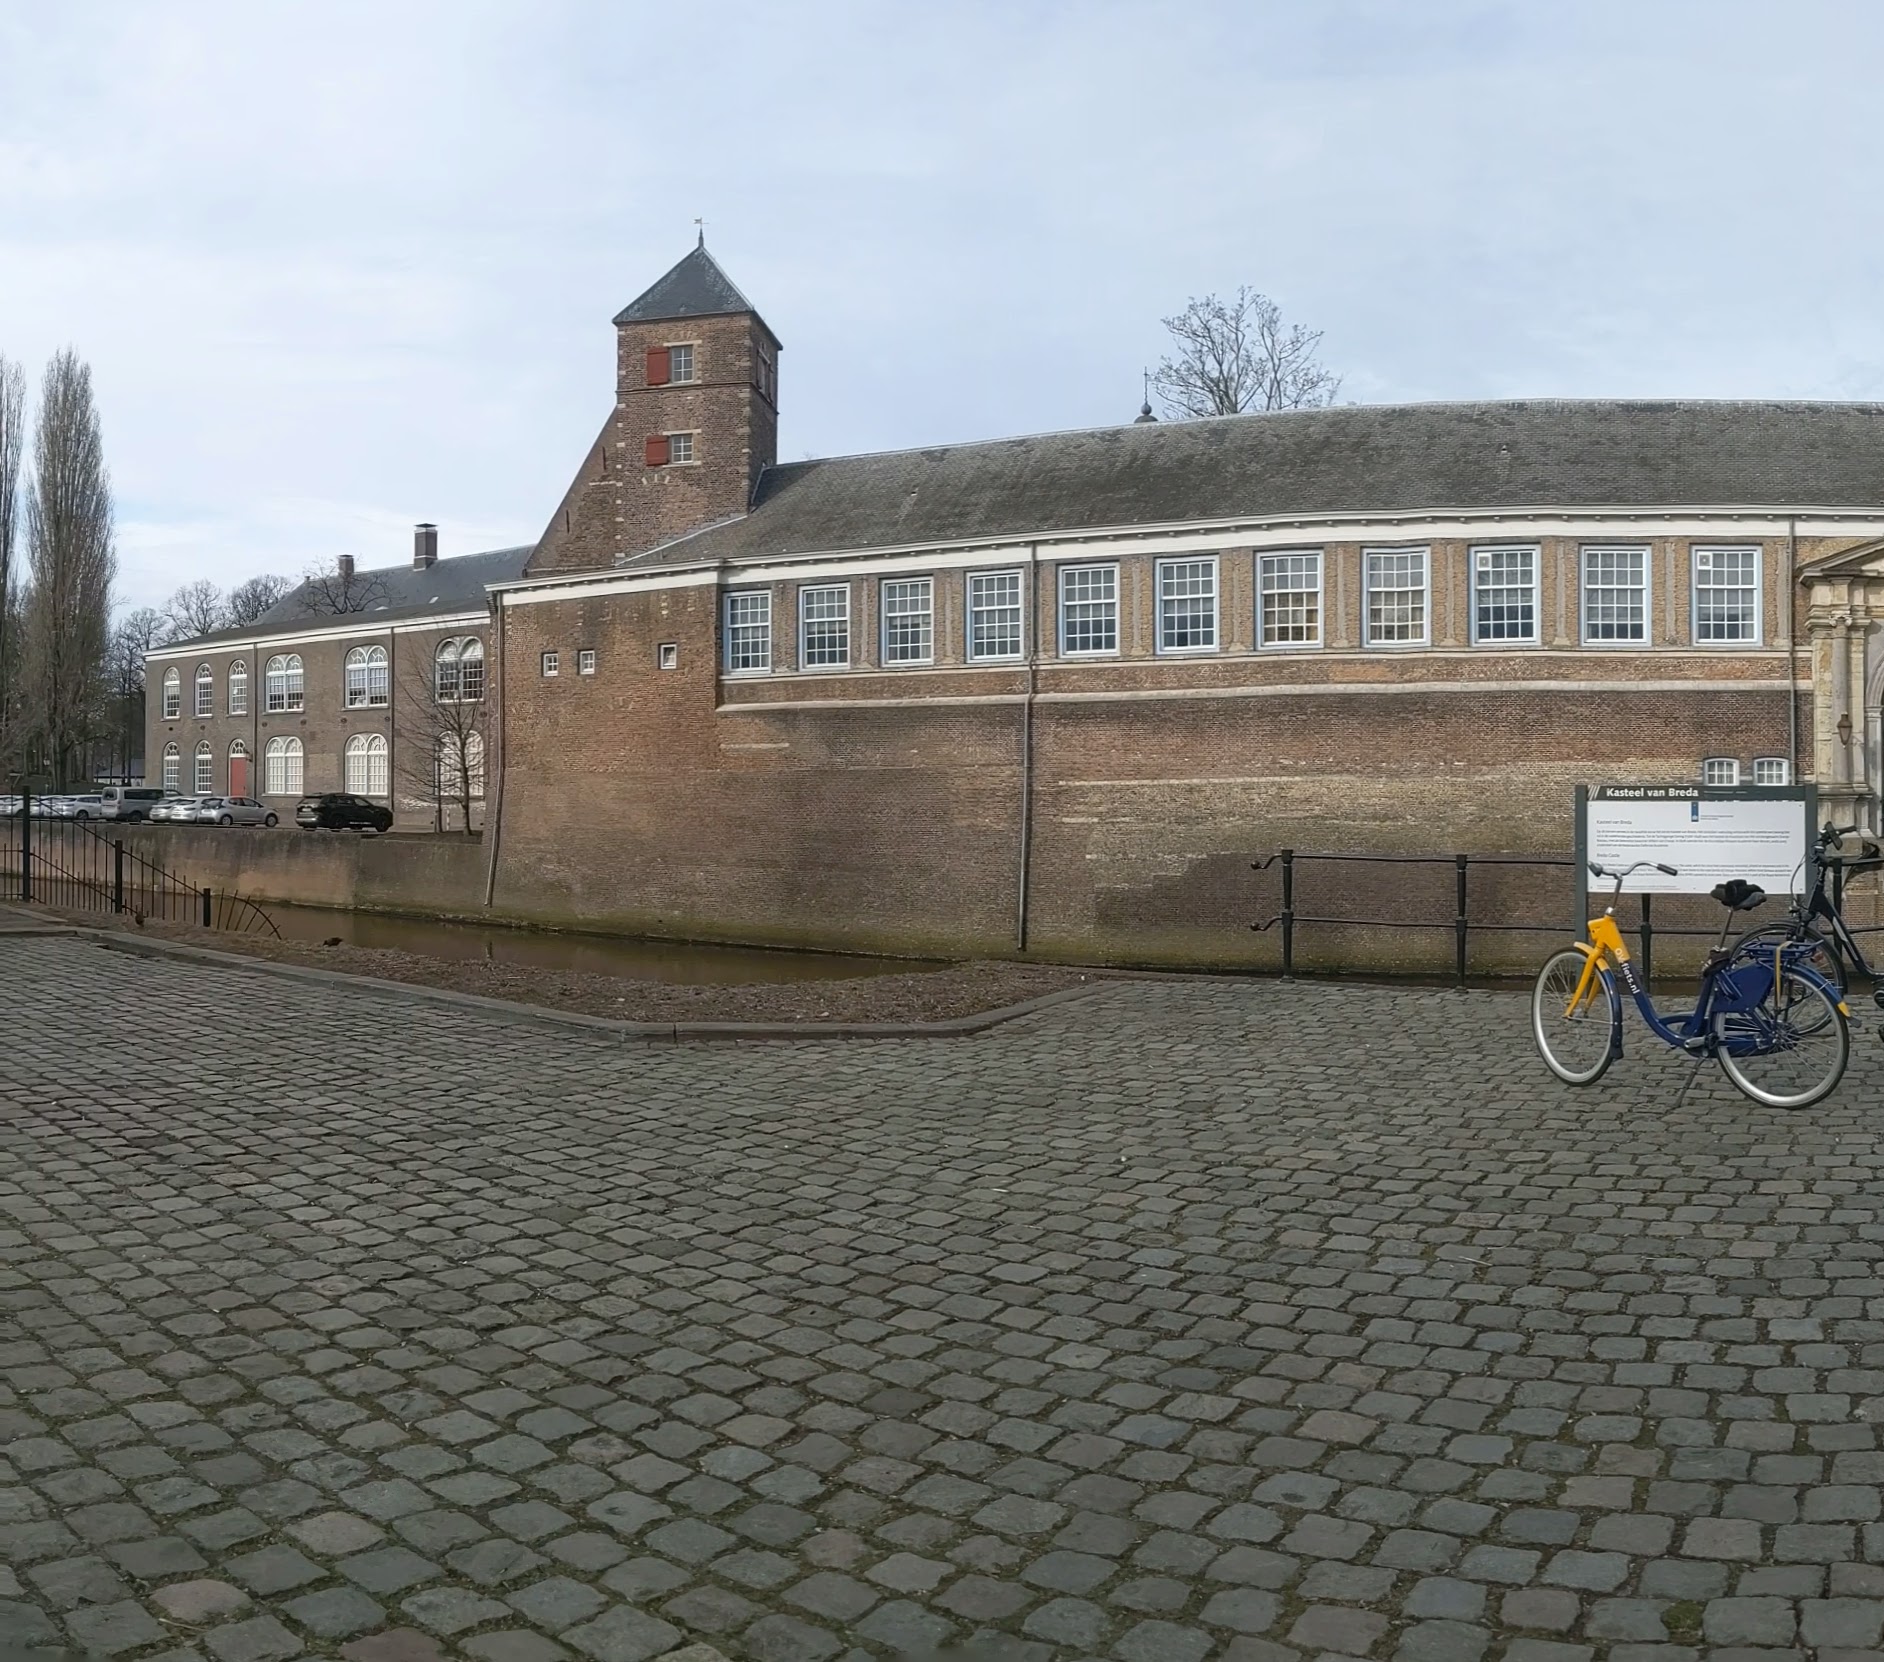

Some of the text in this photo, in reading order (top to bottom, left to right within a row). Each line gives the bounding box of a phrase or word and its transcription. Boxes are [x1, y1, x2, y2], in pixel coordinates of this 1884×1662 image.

[1606, 787, 1699, 797] Kasteel van Breda
